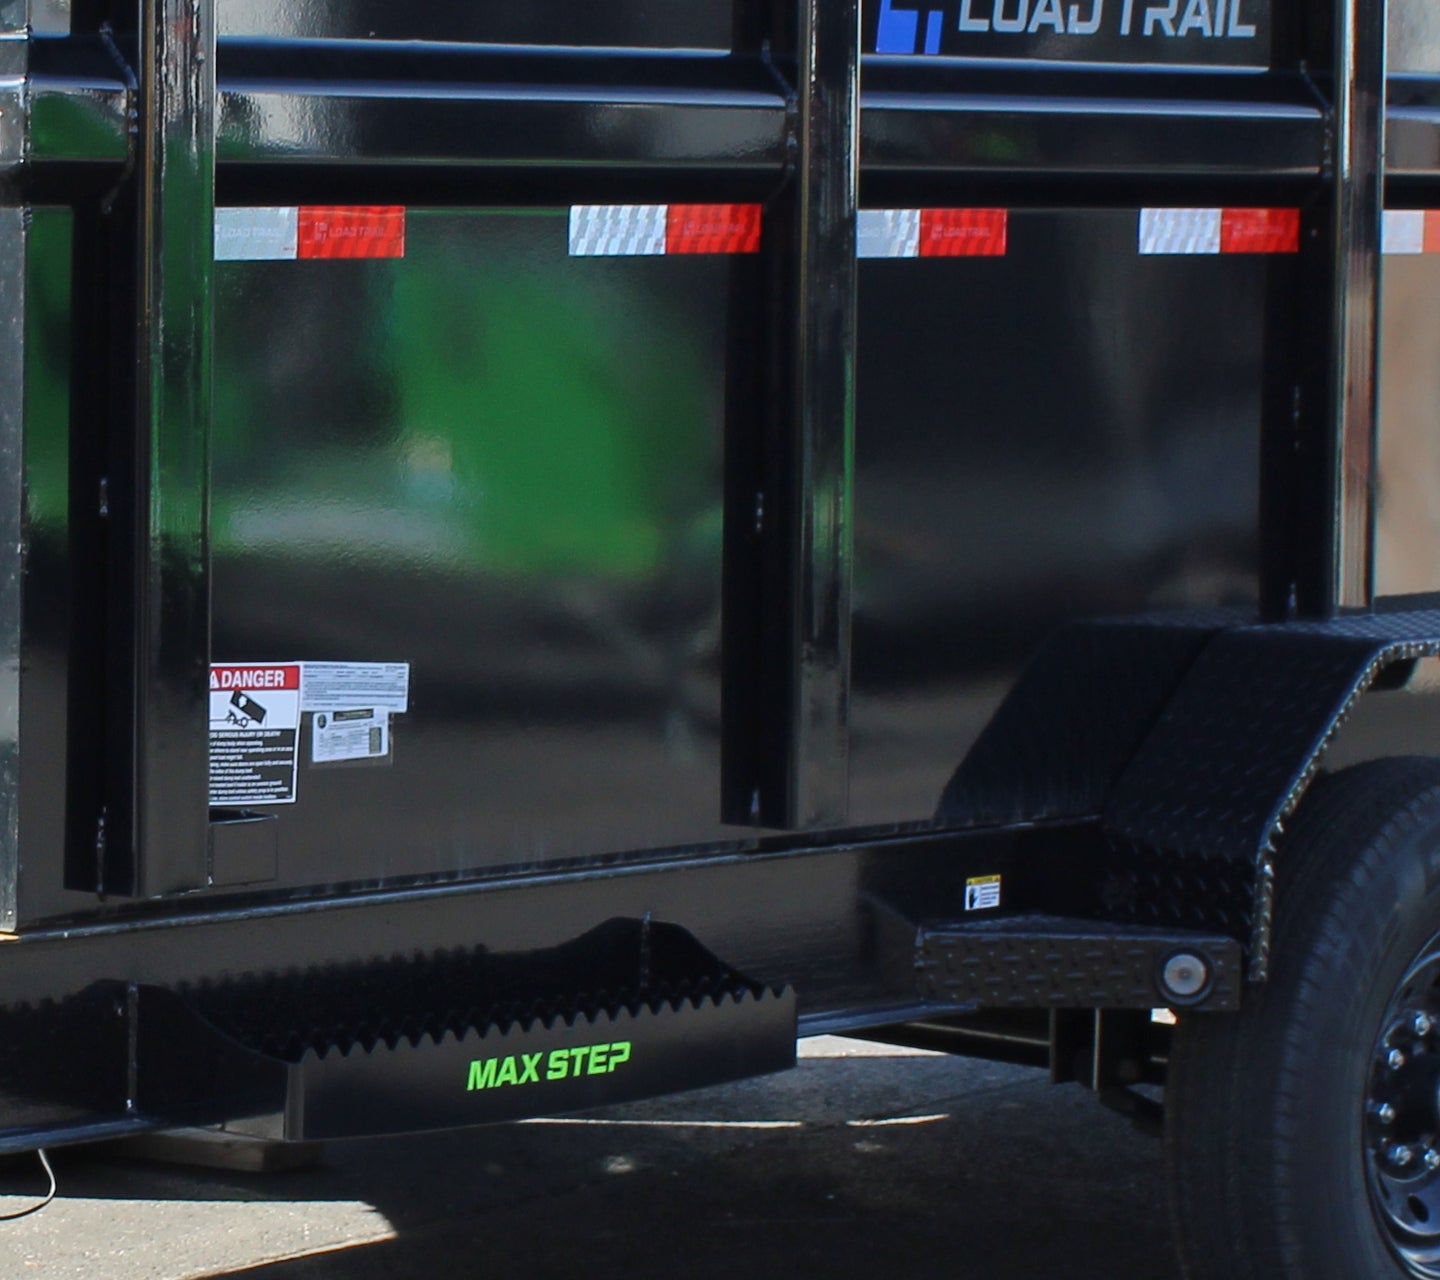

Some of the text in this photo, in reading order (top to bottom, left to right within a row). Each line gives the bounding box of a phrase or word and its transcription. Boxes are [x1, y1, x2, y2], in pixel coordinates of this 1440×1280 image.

[221, 669, 285, 688] DANGER
[467, 1041, 633, 1091] MAX STEP
